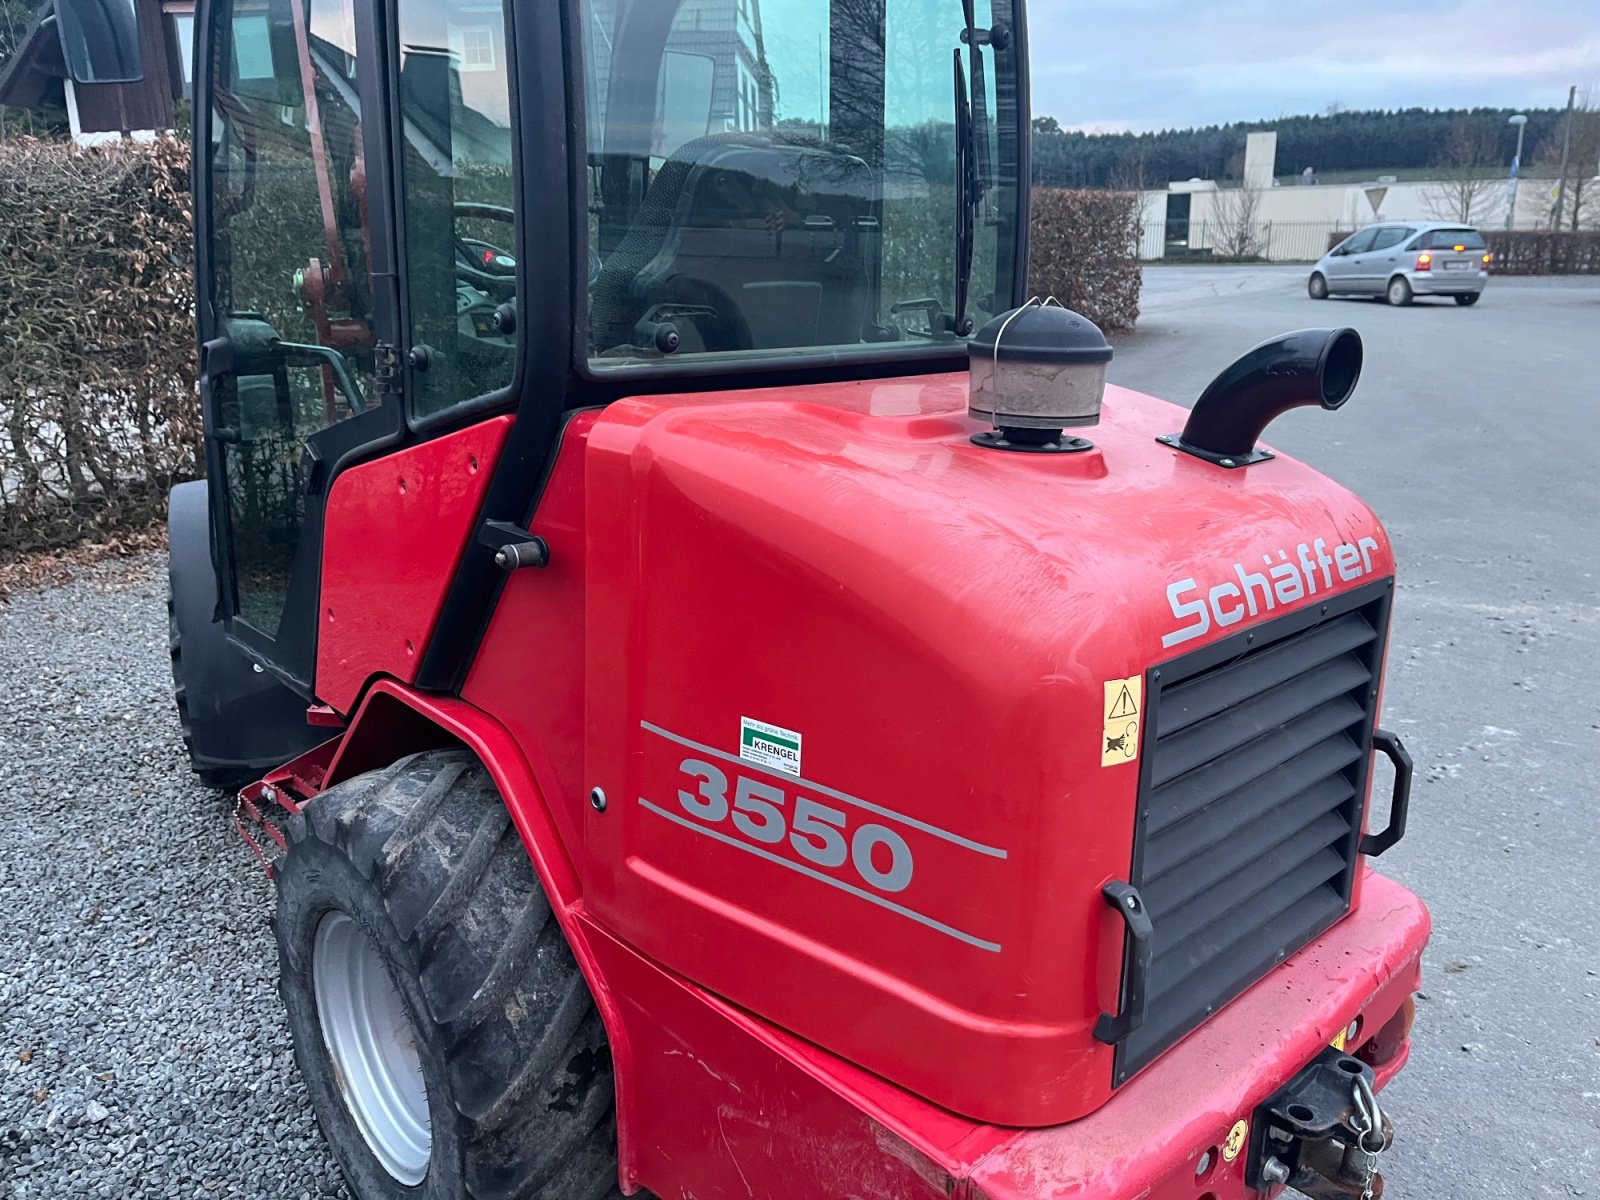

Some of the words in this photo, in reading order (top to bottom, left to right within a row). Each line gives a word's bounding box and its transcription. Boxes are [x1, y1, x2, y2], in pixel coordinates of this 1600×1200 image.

[1162, 536, 1378, 648] Schäffer
[754, 740, 799, 762] KRENGEL
[677, 758, 914, 892] 3550
